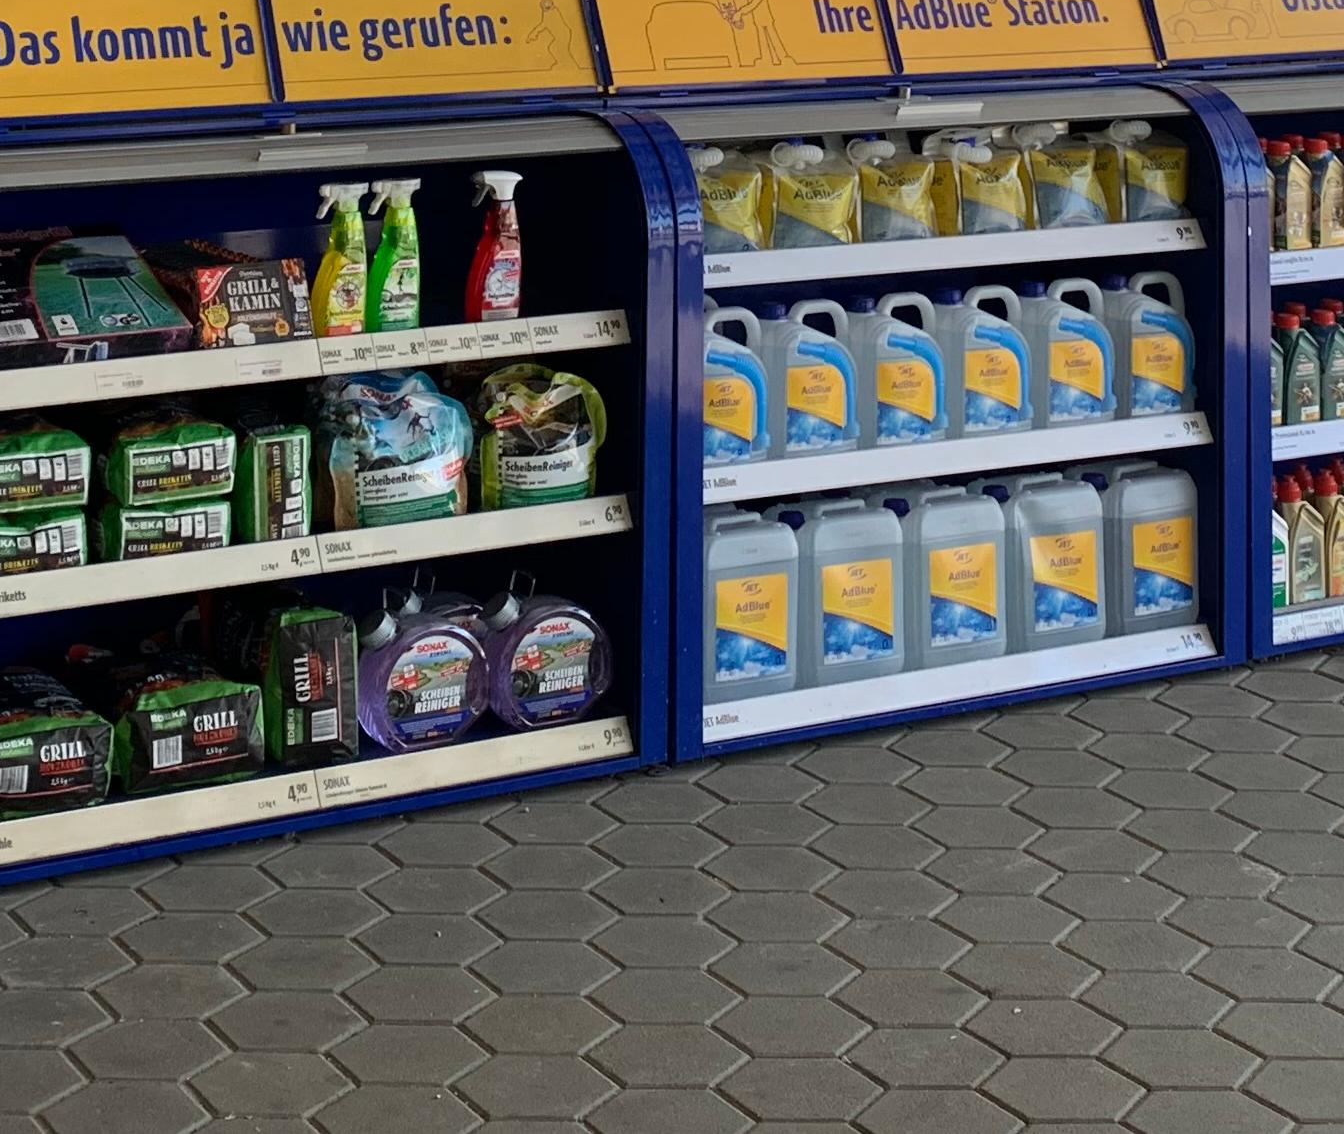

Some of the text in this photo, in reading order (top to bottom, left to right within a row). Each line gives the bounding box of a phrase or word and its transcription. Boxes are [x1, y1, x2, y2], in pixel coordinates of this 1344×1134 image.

[72, 14, 207, 63] kommt
[220, 9, 255, 69] ja
[281, 8, 350, 54] wie
[362, 2, 512, 62] gerufen:
[229, 292, 282, 312] KAMIN
[533, 325, 560, 337] SONAX
[324, 541, 353, 556] SONAX
[540, 621, 570, 635] SONAX
[416, 640, 448, 654] SONAX
[293, 653, 311, 703] GRILL
[544, 664, 584, 682] SCHEIBEN
[420, 684, 461, 702] SCHEIBEN
[538, 674, 584, 695] REINIGER
[414, 694, 461, 715] REINIGER
[192, 710, 239, 733] GRILL
[39, 740, 87, 763] GRILL
[322, 775, 351, 790] SONAX
